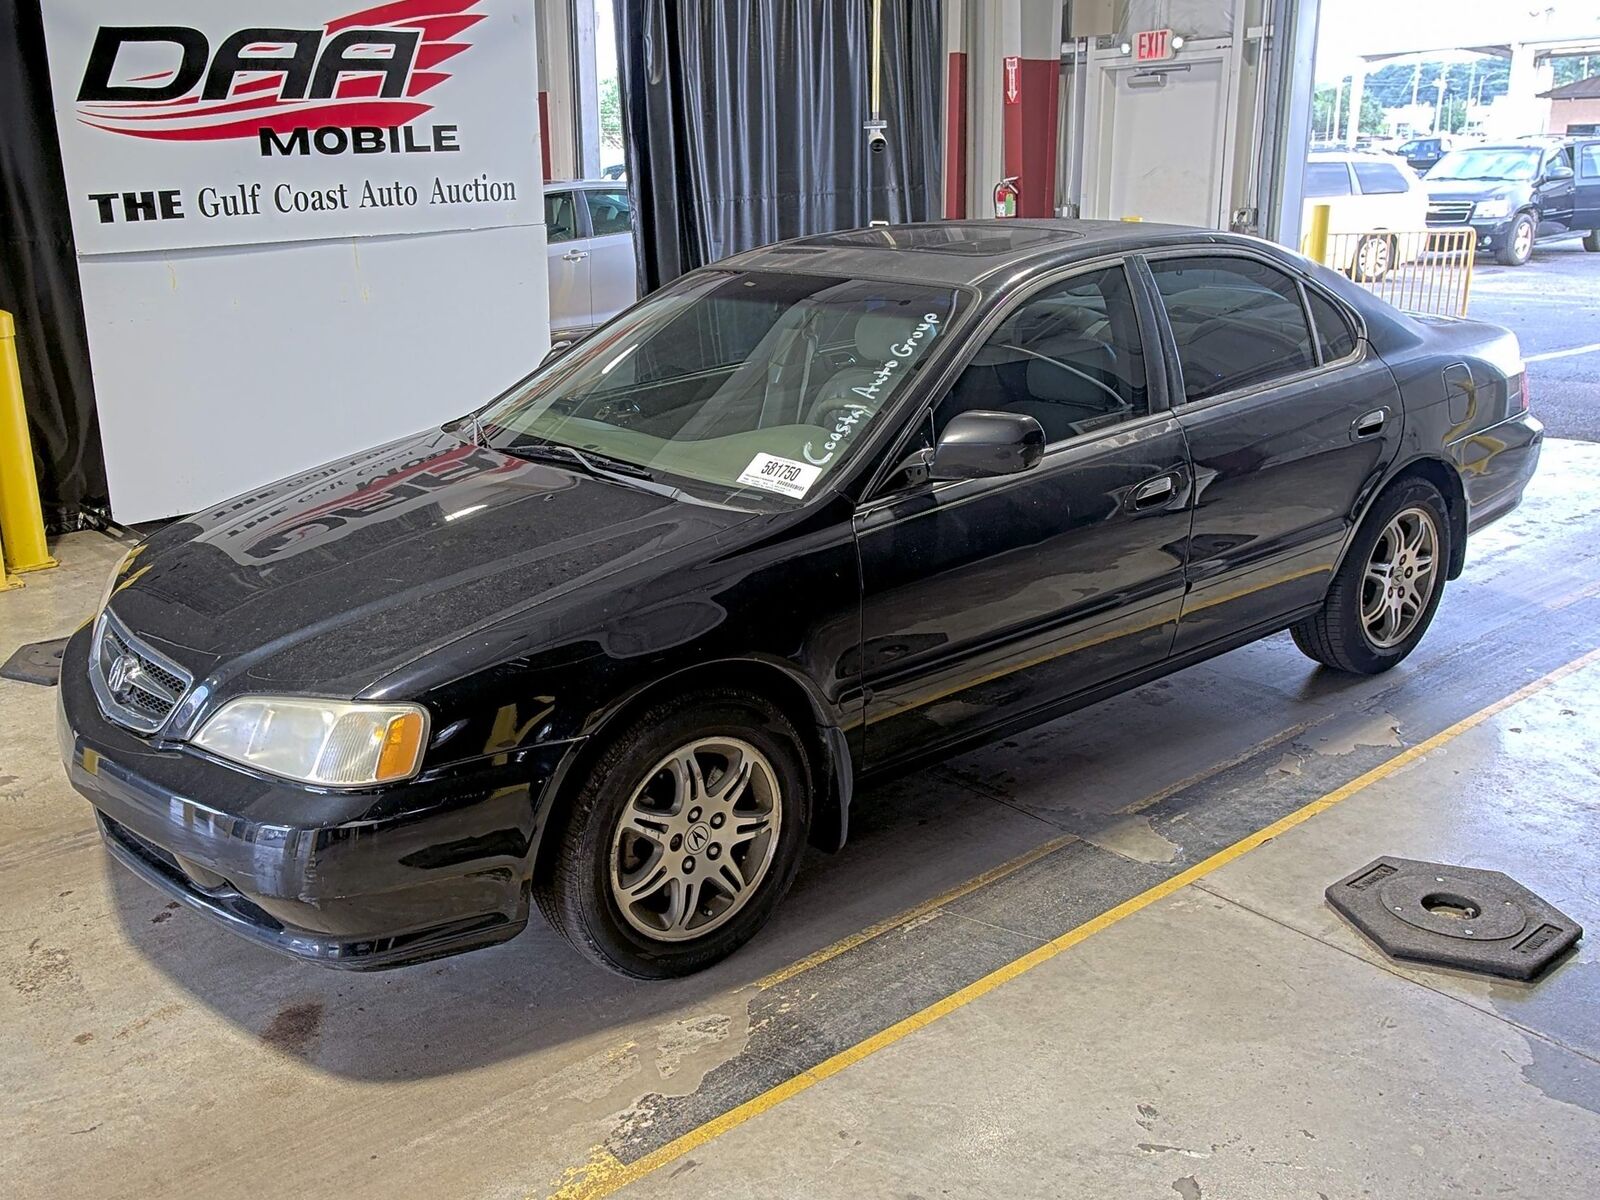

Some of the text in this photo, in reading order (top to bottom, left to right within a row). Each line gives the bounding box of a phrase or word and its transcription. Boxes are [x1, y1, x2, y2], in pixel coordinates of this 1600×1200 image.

[76, 26, 420, 102] DAA
[1138, 31, 1167, 59] EXIT
[260, 124, 461, 157] MOBILE
[88, 172, 517, 223] THE Gulf Coast Auto Auction
[803, 312, 940, 466] Coastal Auto Group
[760, 460, 802, 482] 581750
